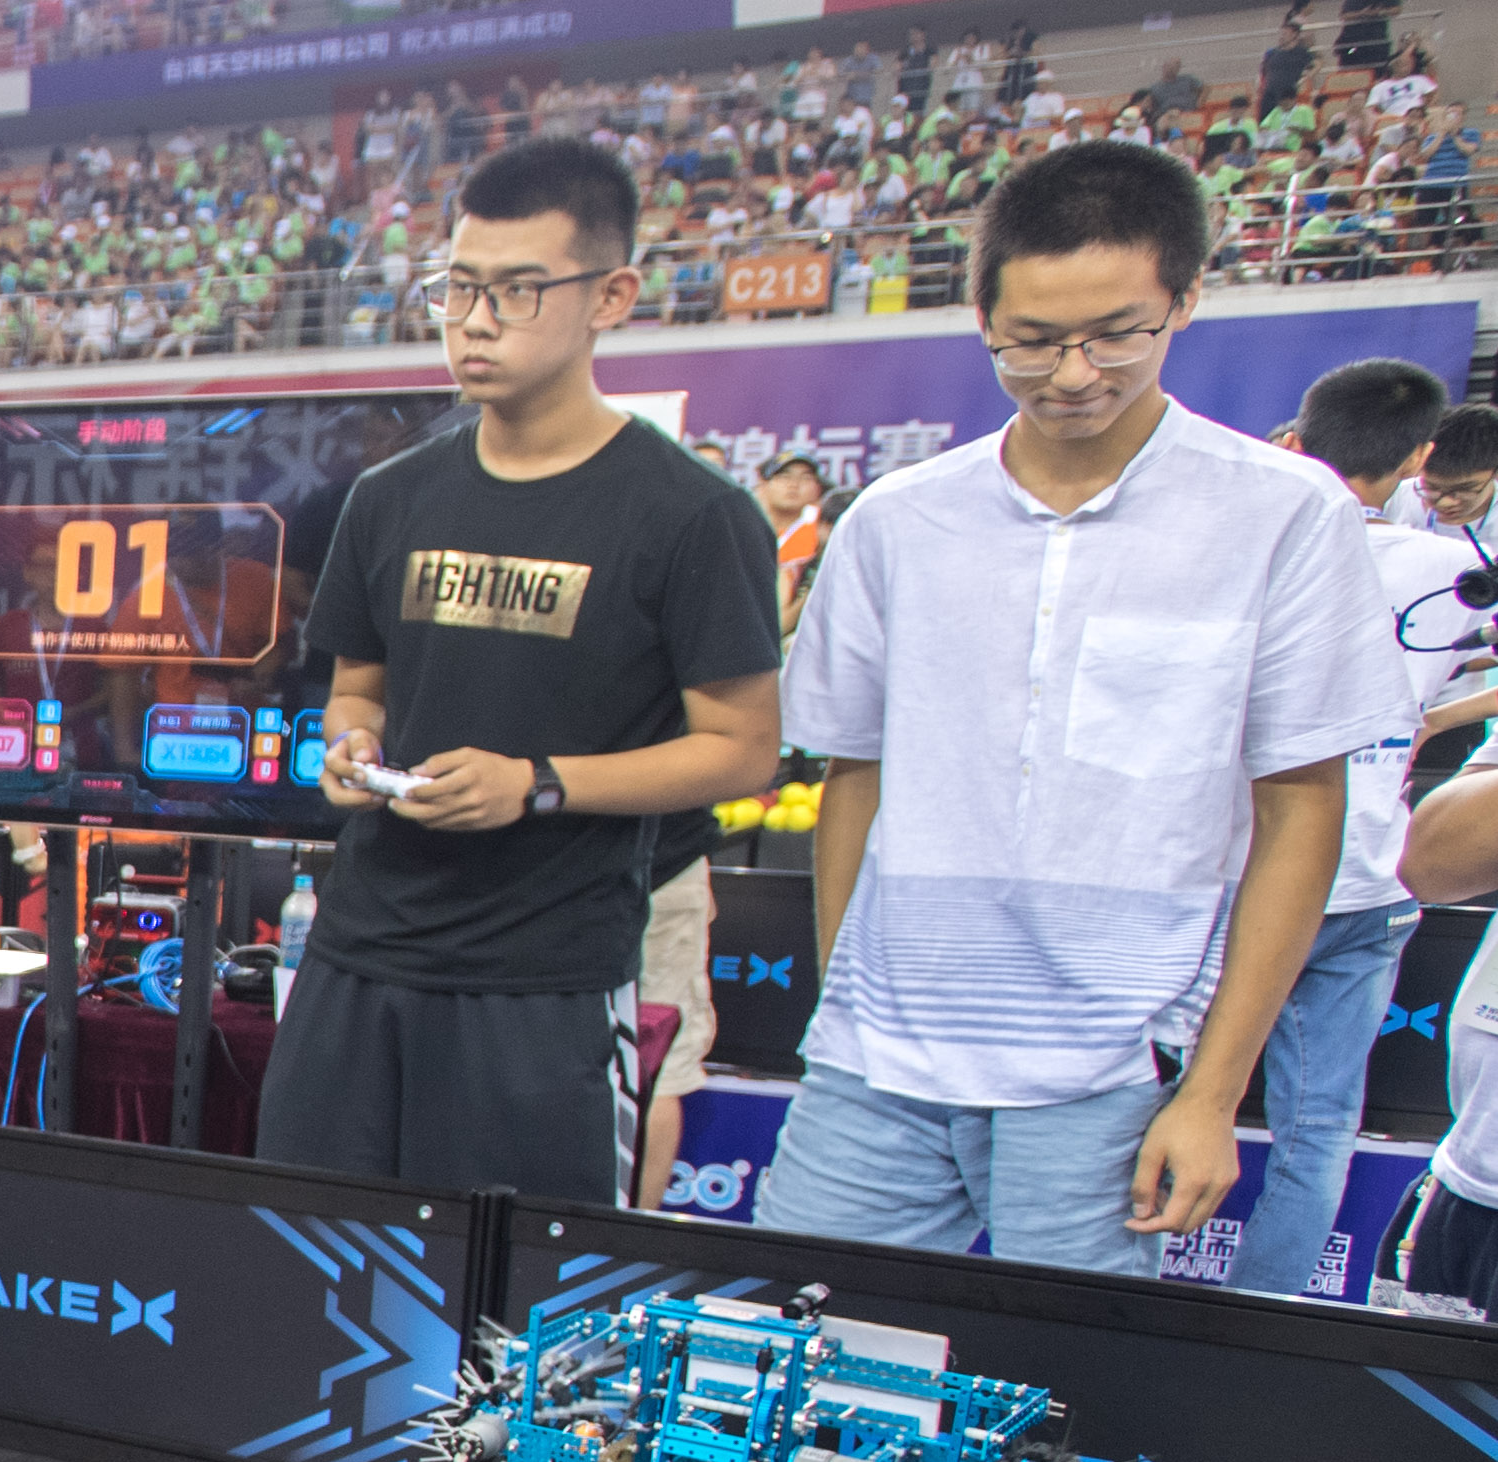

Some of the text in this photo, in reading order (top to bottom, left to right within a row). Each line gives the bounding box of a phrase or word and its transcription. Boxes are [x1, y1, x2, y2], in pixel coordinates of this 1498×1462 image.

[727, 262, 823, 303] C213
[77, 418, 167, 444] 手动阶段
[54, 519, 170, 619] 01
[416, 560, 563, 616] FGHTING
